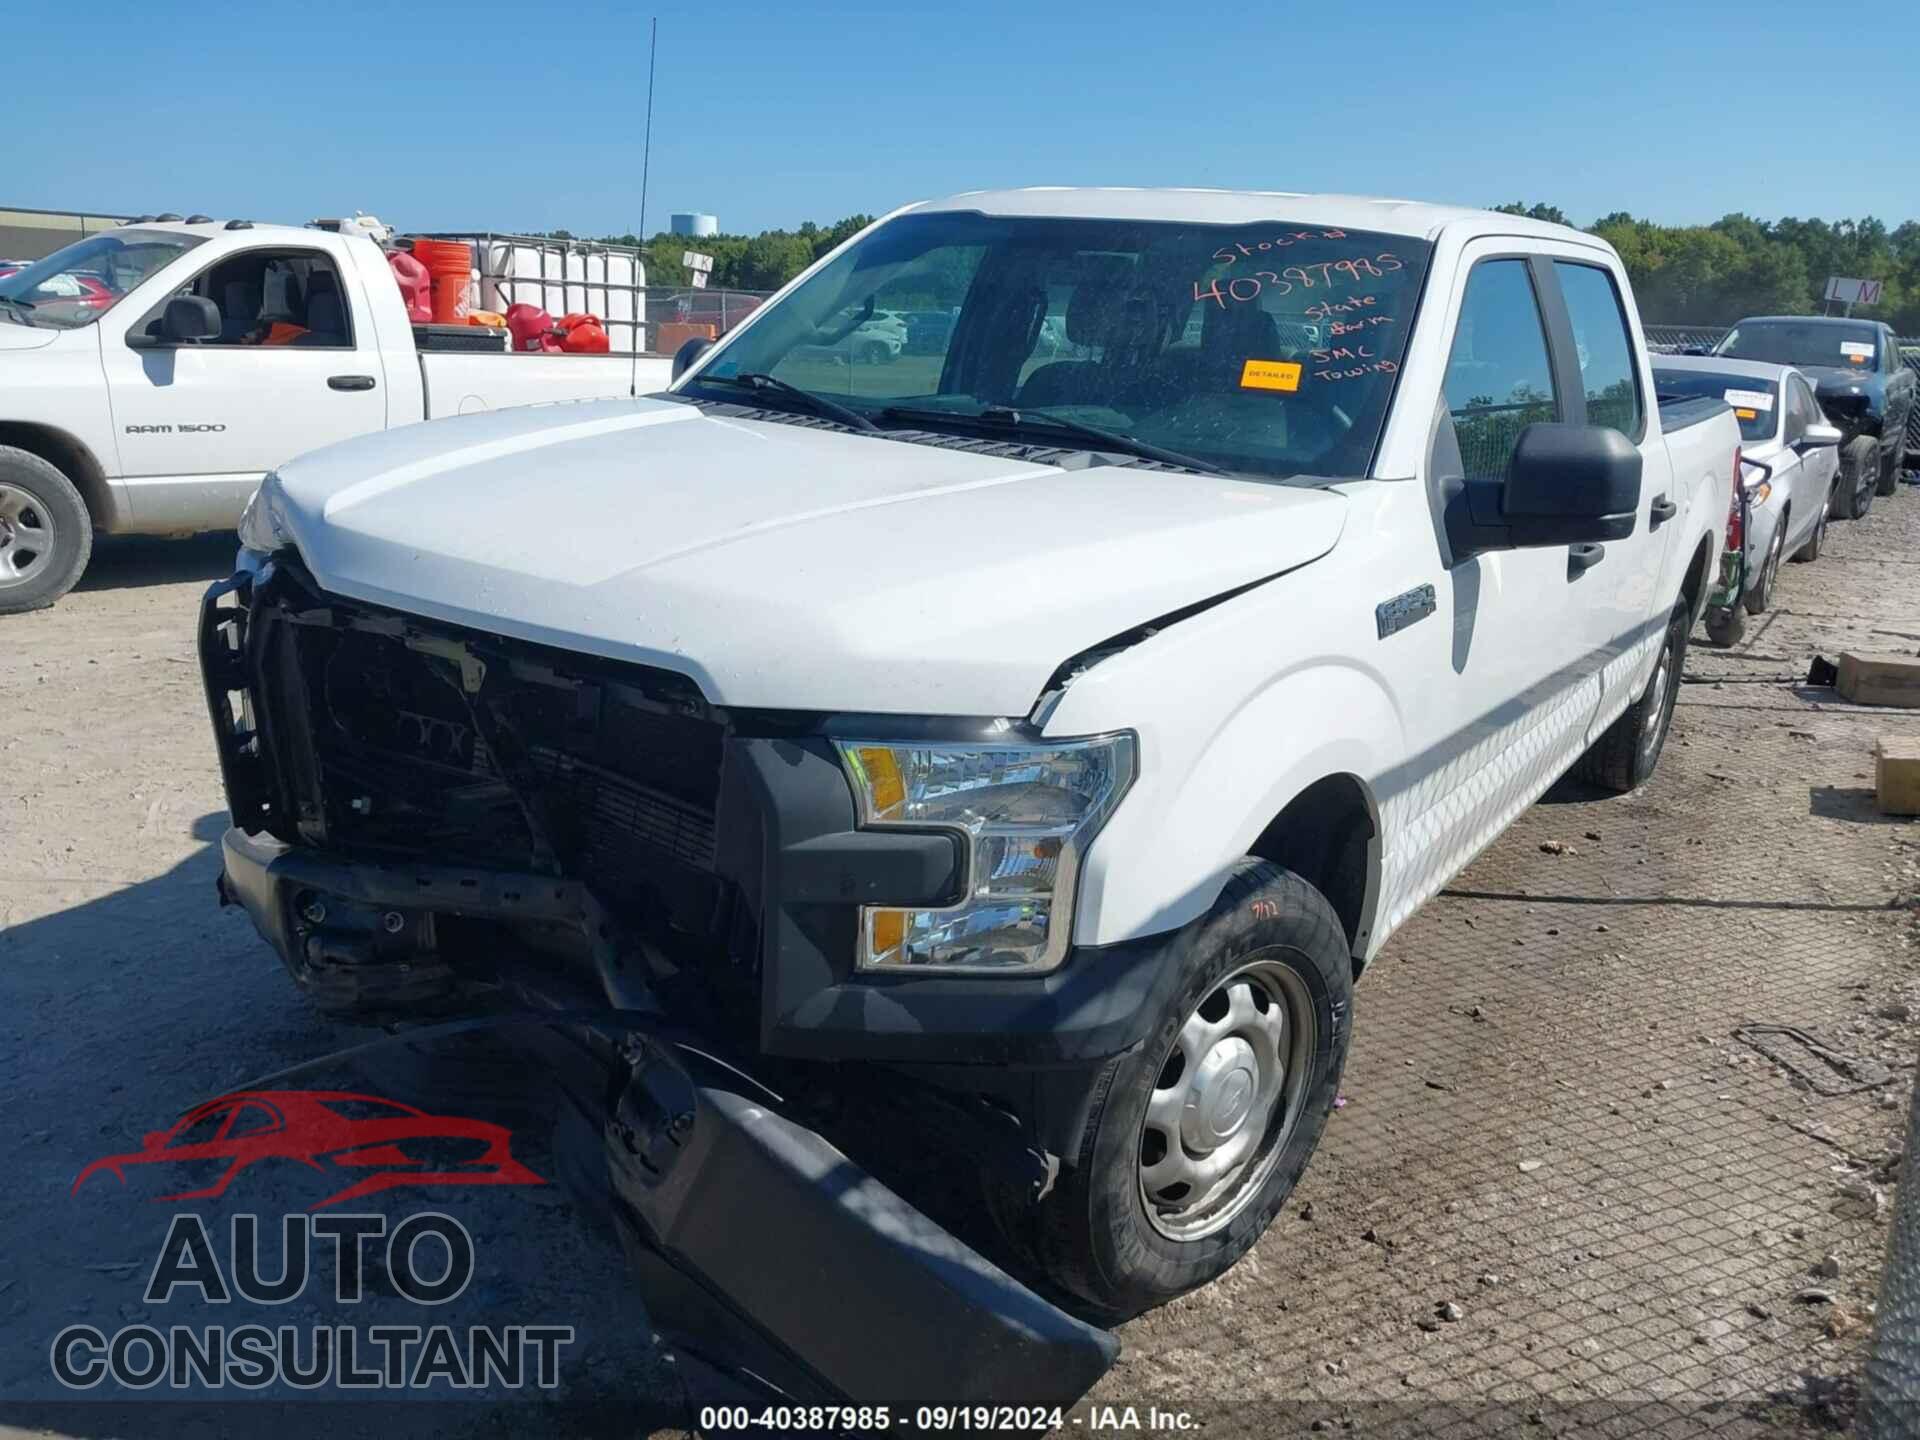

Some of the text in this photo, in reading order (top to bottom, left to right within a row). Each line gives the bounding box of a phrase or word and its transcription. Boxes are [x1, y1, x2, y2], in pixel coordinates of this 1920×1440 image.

[1193, 253, 1403, 310] 40387985
[1831, 279, 1880, 304] L M
[1248, 370, 1294, 380] DETAILED
[1313, 360, 1397, 381] Towing
[125, 423, 226, 434] RAM 1500
